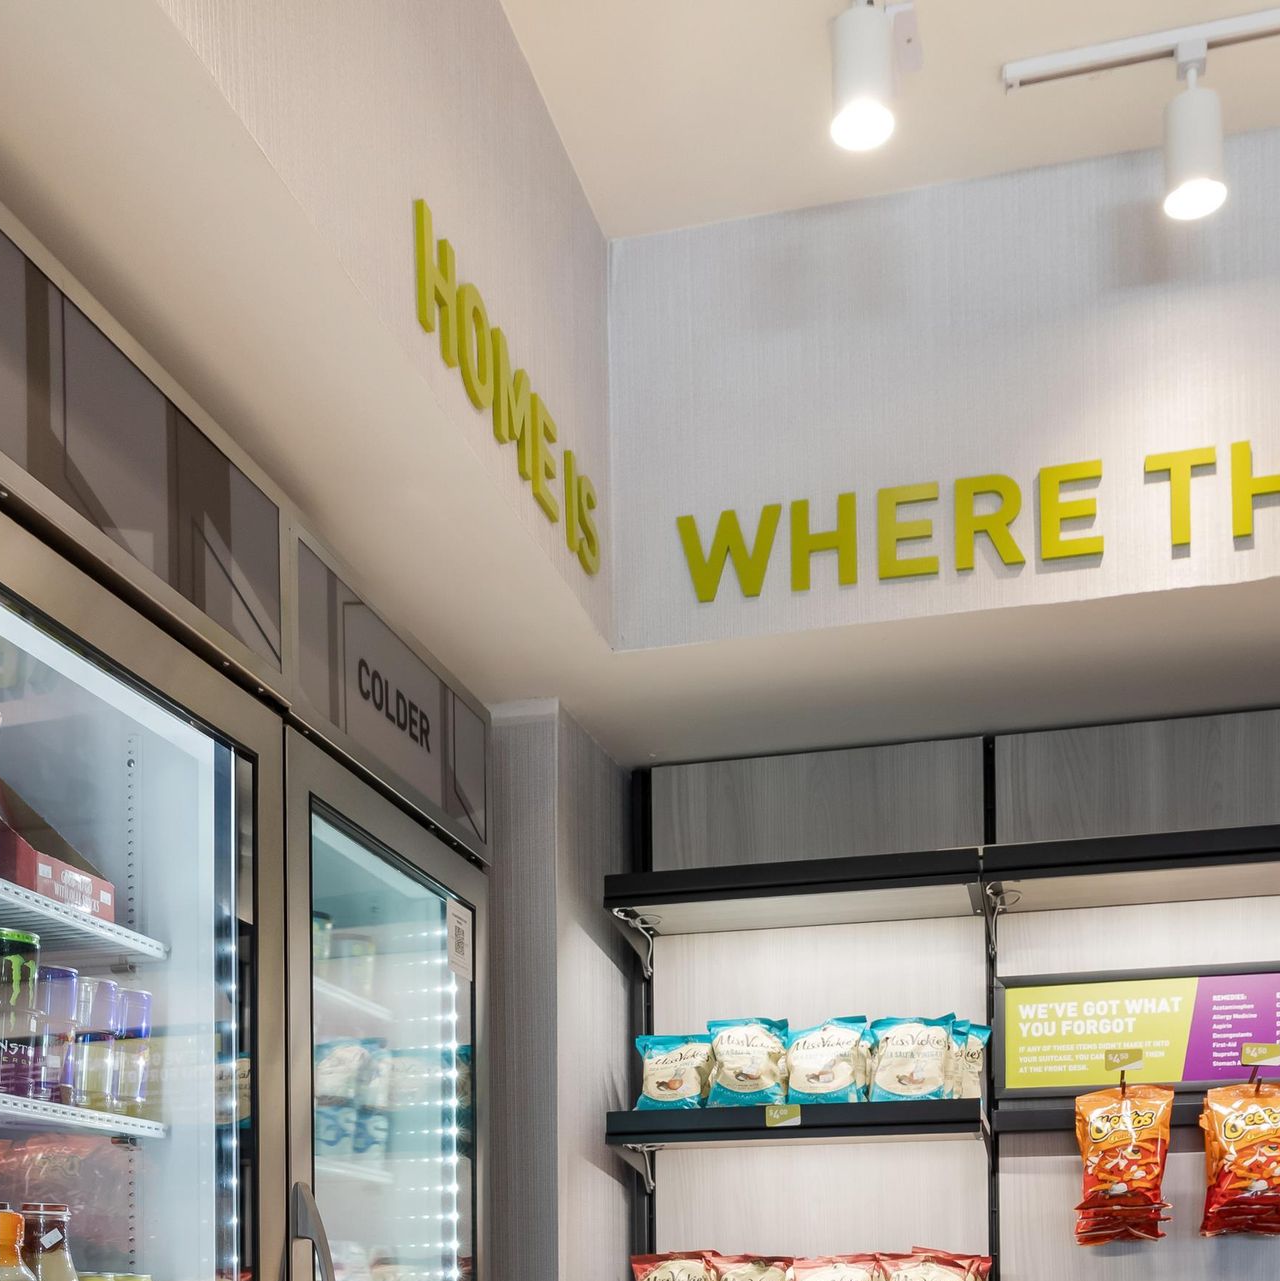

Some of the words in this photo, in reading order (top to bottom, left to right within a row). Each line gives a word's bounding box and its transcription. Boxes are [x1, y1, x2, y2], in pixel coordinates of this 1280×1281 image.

[413, 198, 559, 524] HOME
[563, 449, 601, 577] IS
[676, 458, 1104, 603] WHERE
[358, 658, 431, 753] COLDER
[1019, 1001, 1078, 1019] WE'VE
[1083, 1000, 1120, 1017] GOT
[1123, 996, 1183, 1015] WHAT
[1019, 1020, 1056, 1038] YOU
[1061, 1017, 1136, 1037] FORGOT
[1123, 1041, 1142, 1049] MAKE
[1090, 1109, 1155, 1141] Cheetos
